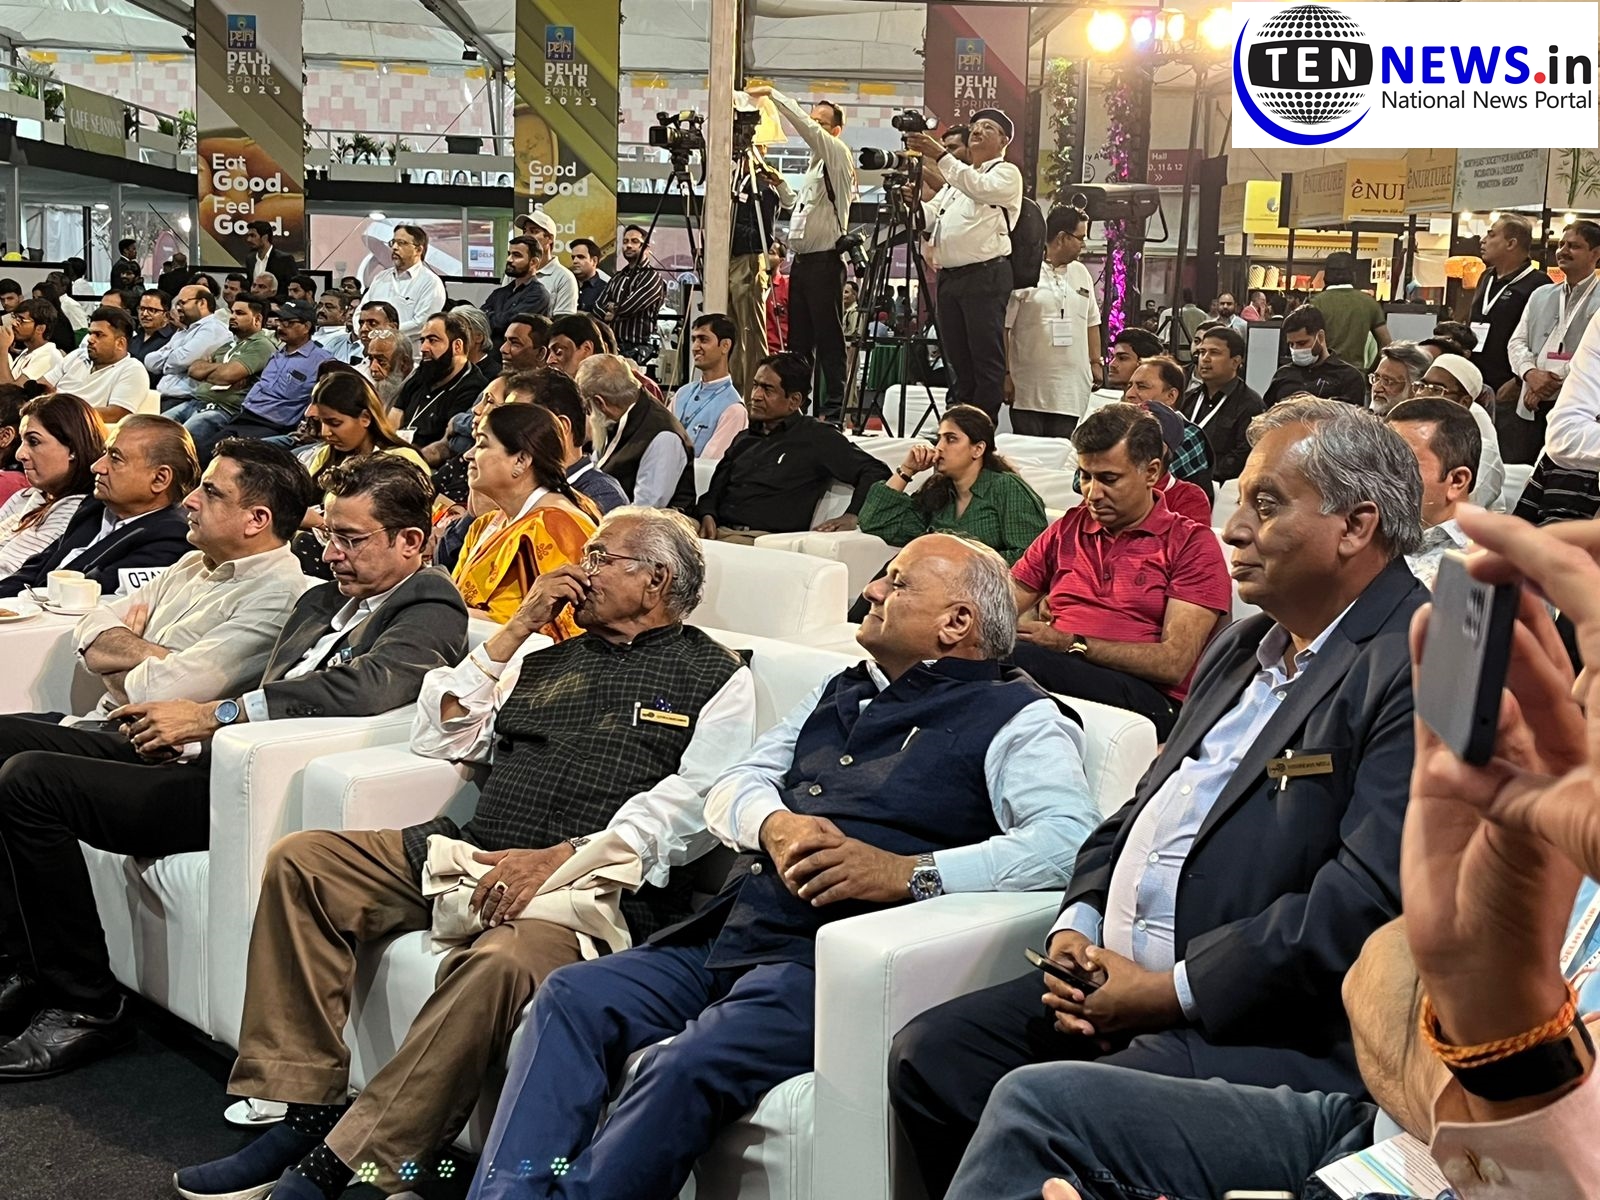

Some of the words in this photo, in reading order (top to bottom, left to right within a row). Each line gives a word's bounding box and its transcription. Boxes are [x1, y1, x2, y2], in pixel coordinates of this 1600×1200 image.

[227, 51, 271, 65] DELHI
[227, 63, 271, 76] FAIR
[544, 62, 588, 75] DELHI
[227, 76, 274, 85] SPRING
[544, 74, 587, 87] FAIR
[954, 75, 997, 88] DELHI
[227, 85, 281, 95] 2023
[545, 87, 591, 97] SPRING
[954, 86, 997, 99] FAIR
[544, 96, 597, 106] 2023
[954, 99, 1000, 109] SPRING
[954, 108, 976, 117] 20
[212, 152, 246, 171] Eat
[528, 160, 577, 177] Good
[212, 170, 289, 193] Good.
[529, 176, 589, 197] Food
[213, 196, 255, 215] Feel
[528, 198, 544, 213] is
[213, 214, 290, 236] God.
